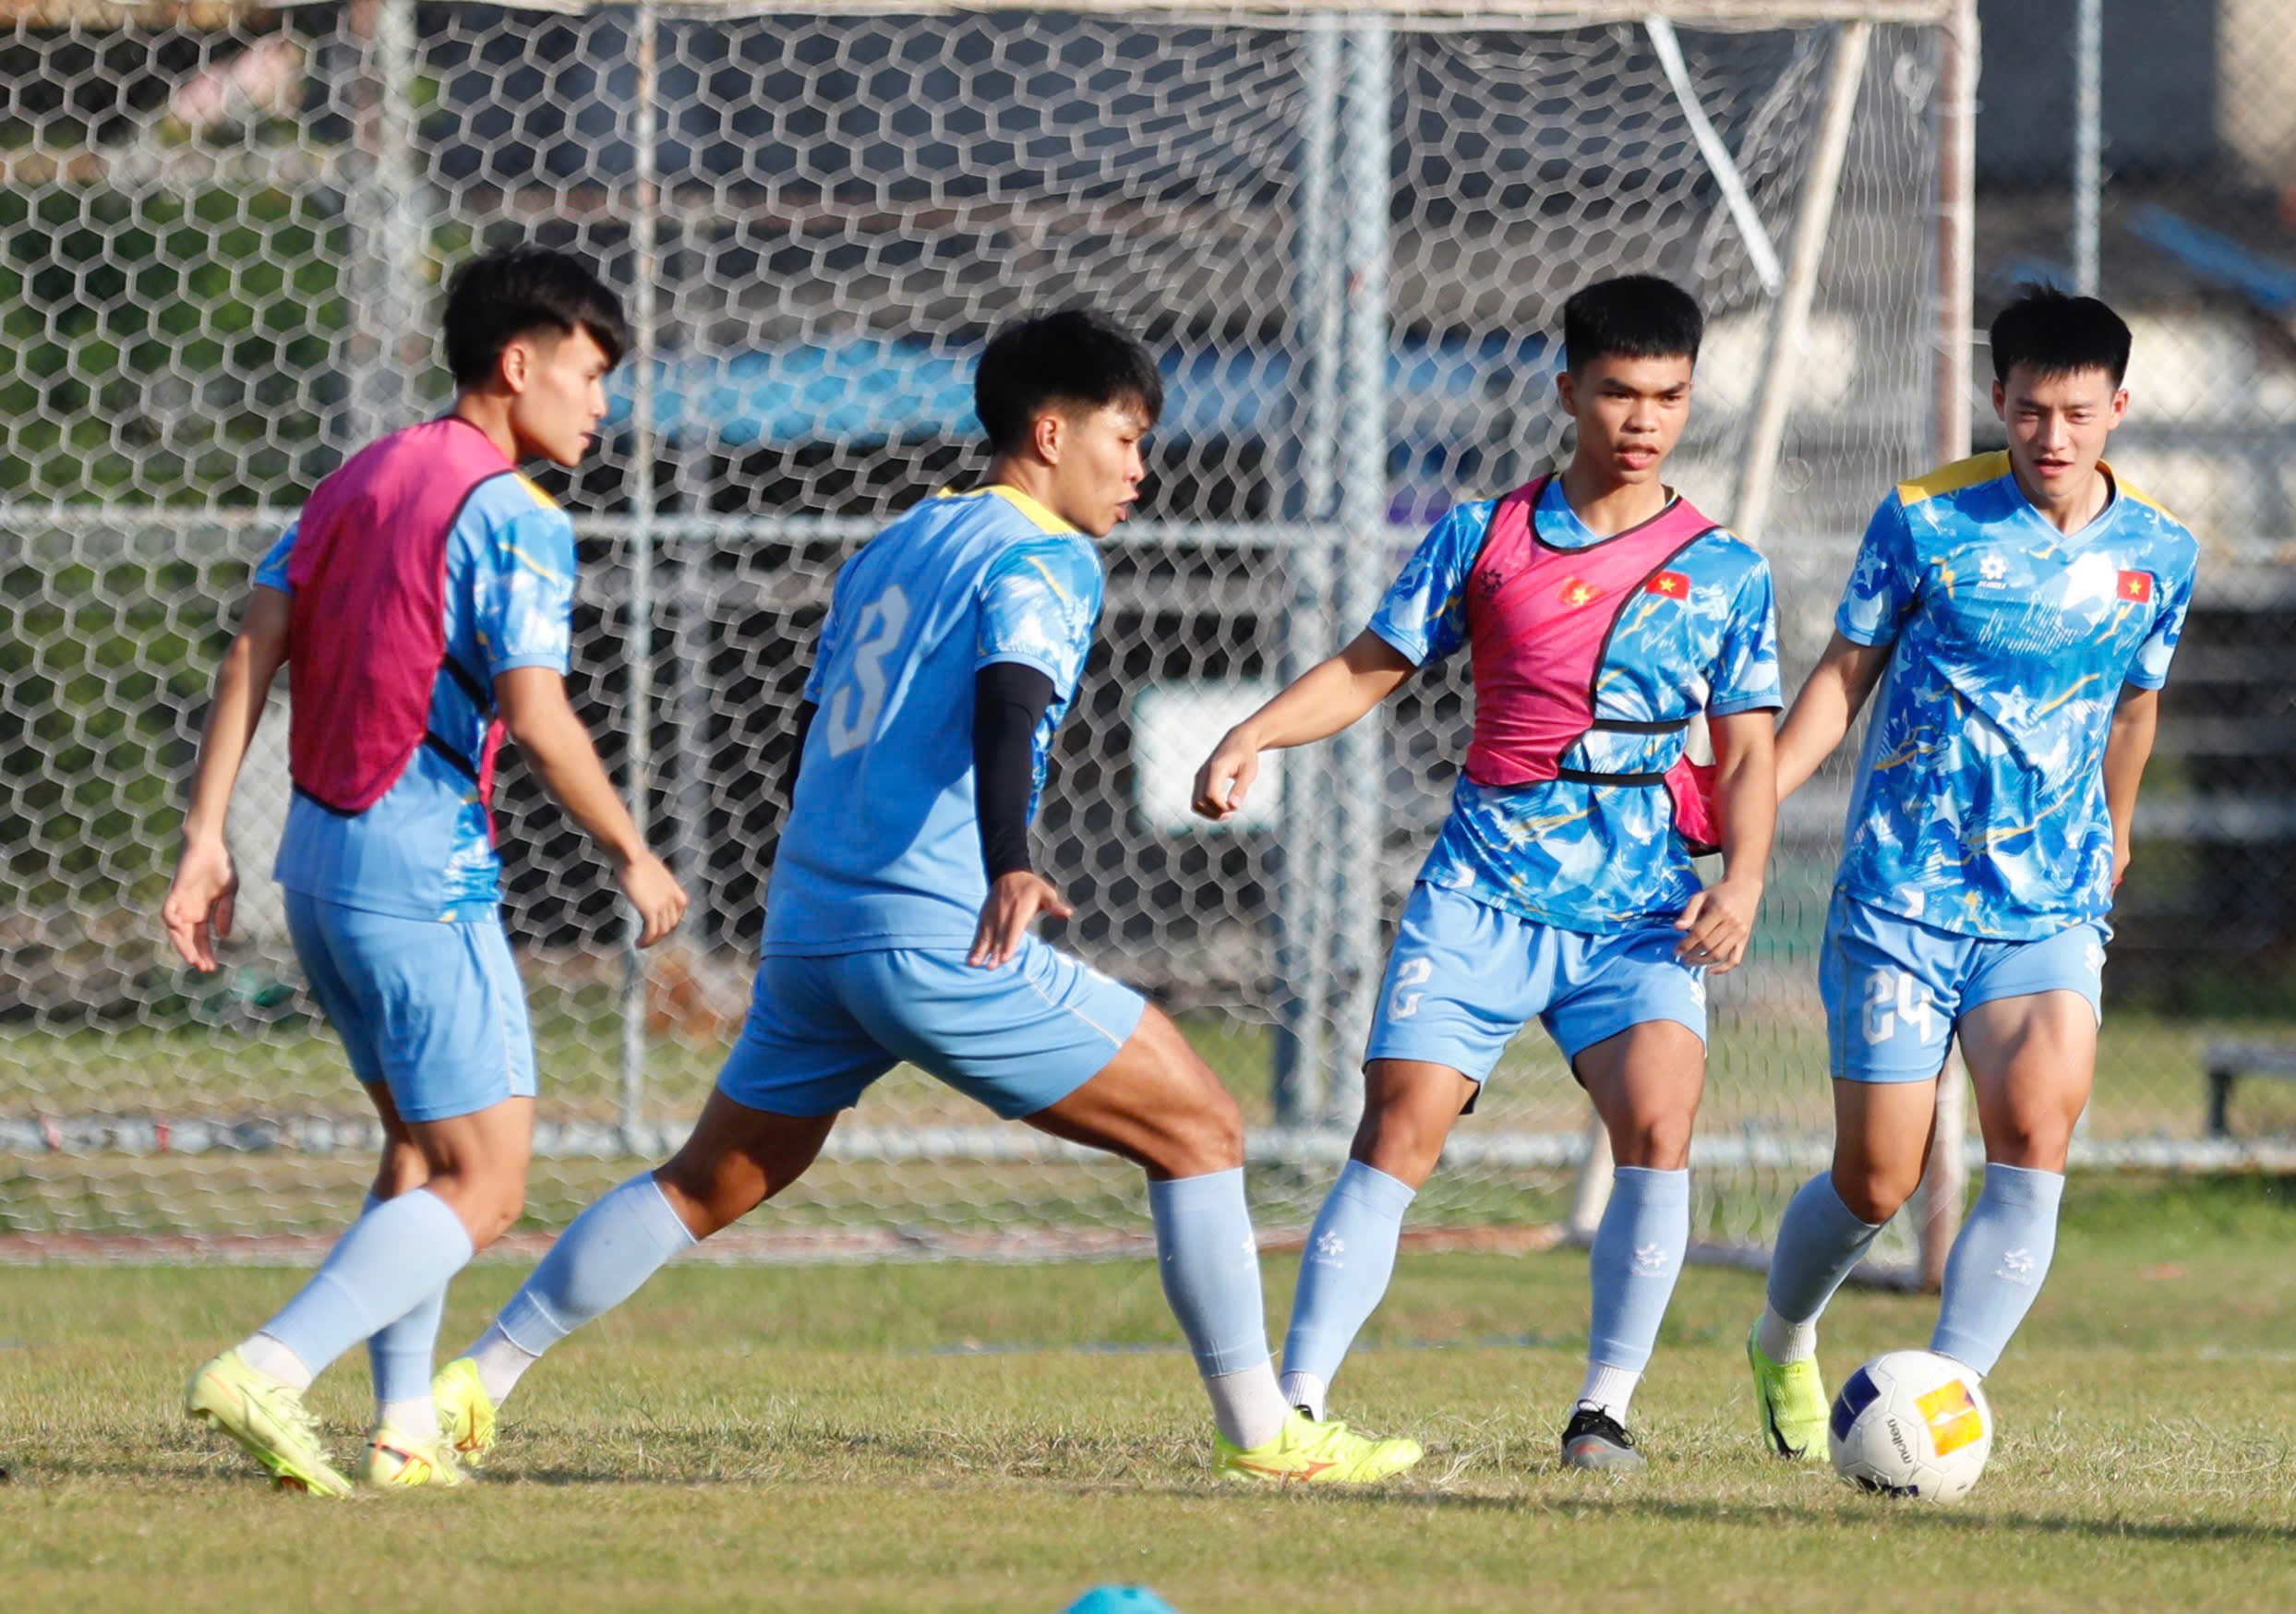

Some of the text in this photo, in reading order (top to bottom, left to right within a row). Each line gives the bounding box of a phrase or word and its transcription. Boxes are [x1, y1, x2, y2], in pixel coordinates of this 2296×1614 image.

[827, 584, 908, 759] 3
[1388, 957, 1433, 1021] 2
[1862, 969, 1931, 1046] 24
[1887, 1418, 1913, 1464] molten
